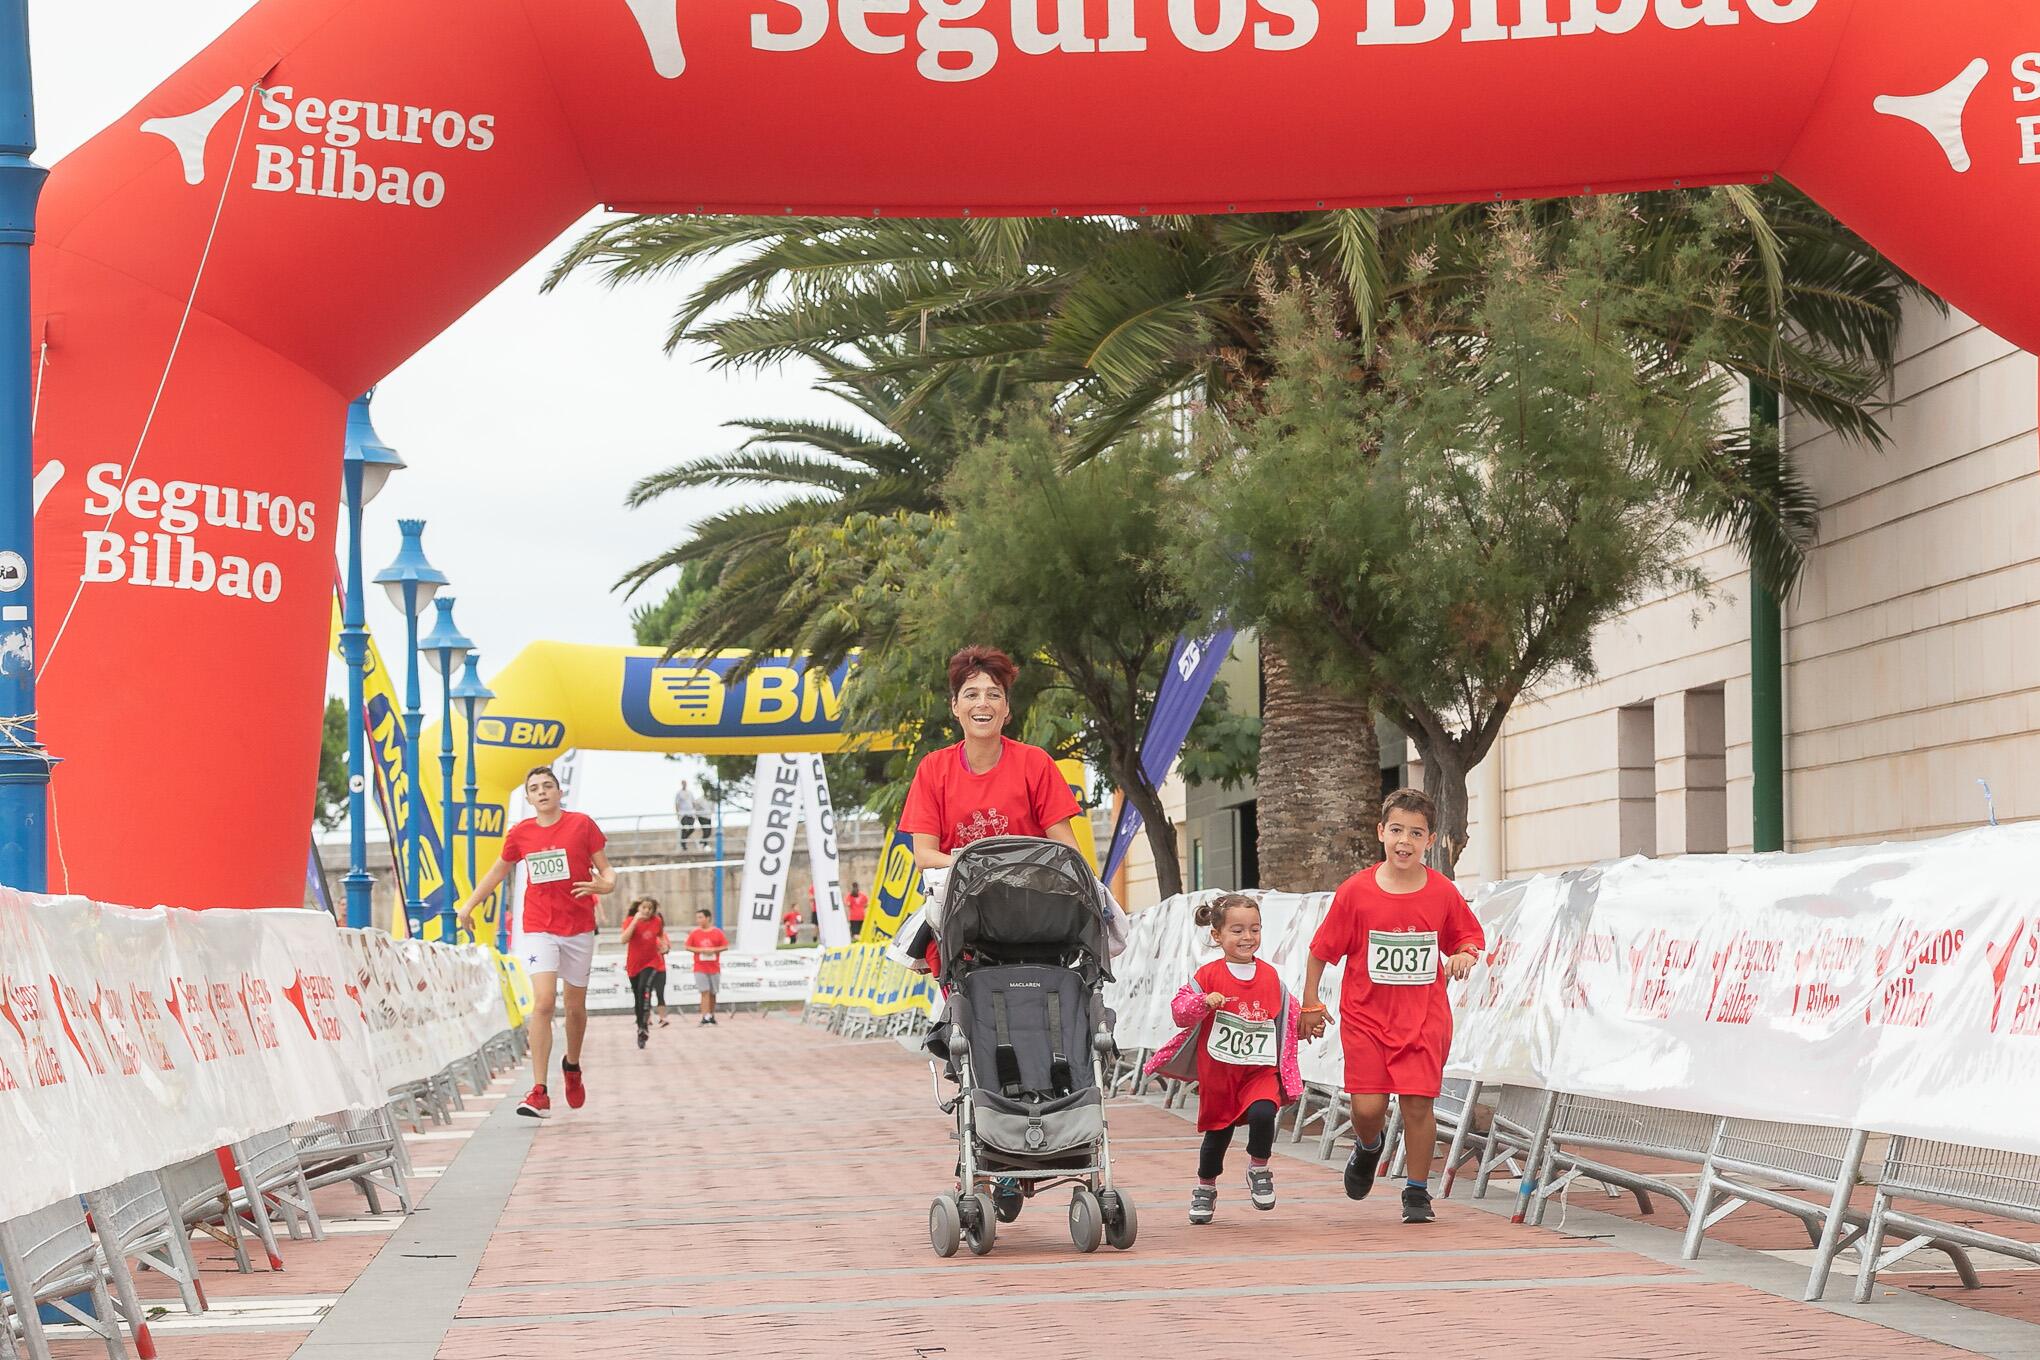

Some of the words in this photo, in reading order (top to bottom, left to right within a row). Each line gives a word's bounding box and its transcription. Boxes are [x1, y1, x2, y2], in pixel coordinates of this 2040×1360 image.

[258, 85, 495, 152] Seguros
[251, 143, 446, 209] Bilbao
[84, 462, 316, 542] Seguros
[79, 530, 282, 603] Bilbao
[510, 721, 559, 746] BM
[532, 858, 564, 875] 2009
[752, 883, 777, 921] EL
[1376, 947, 1431, 973] 2037
[1215, 1026, 1268, 1056] 2037
